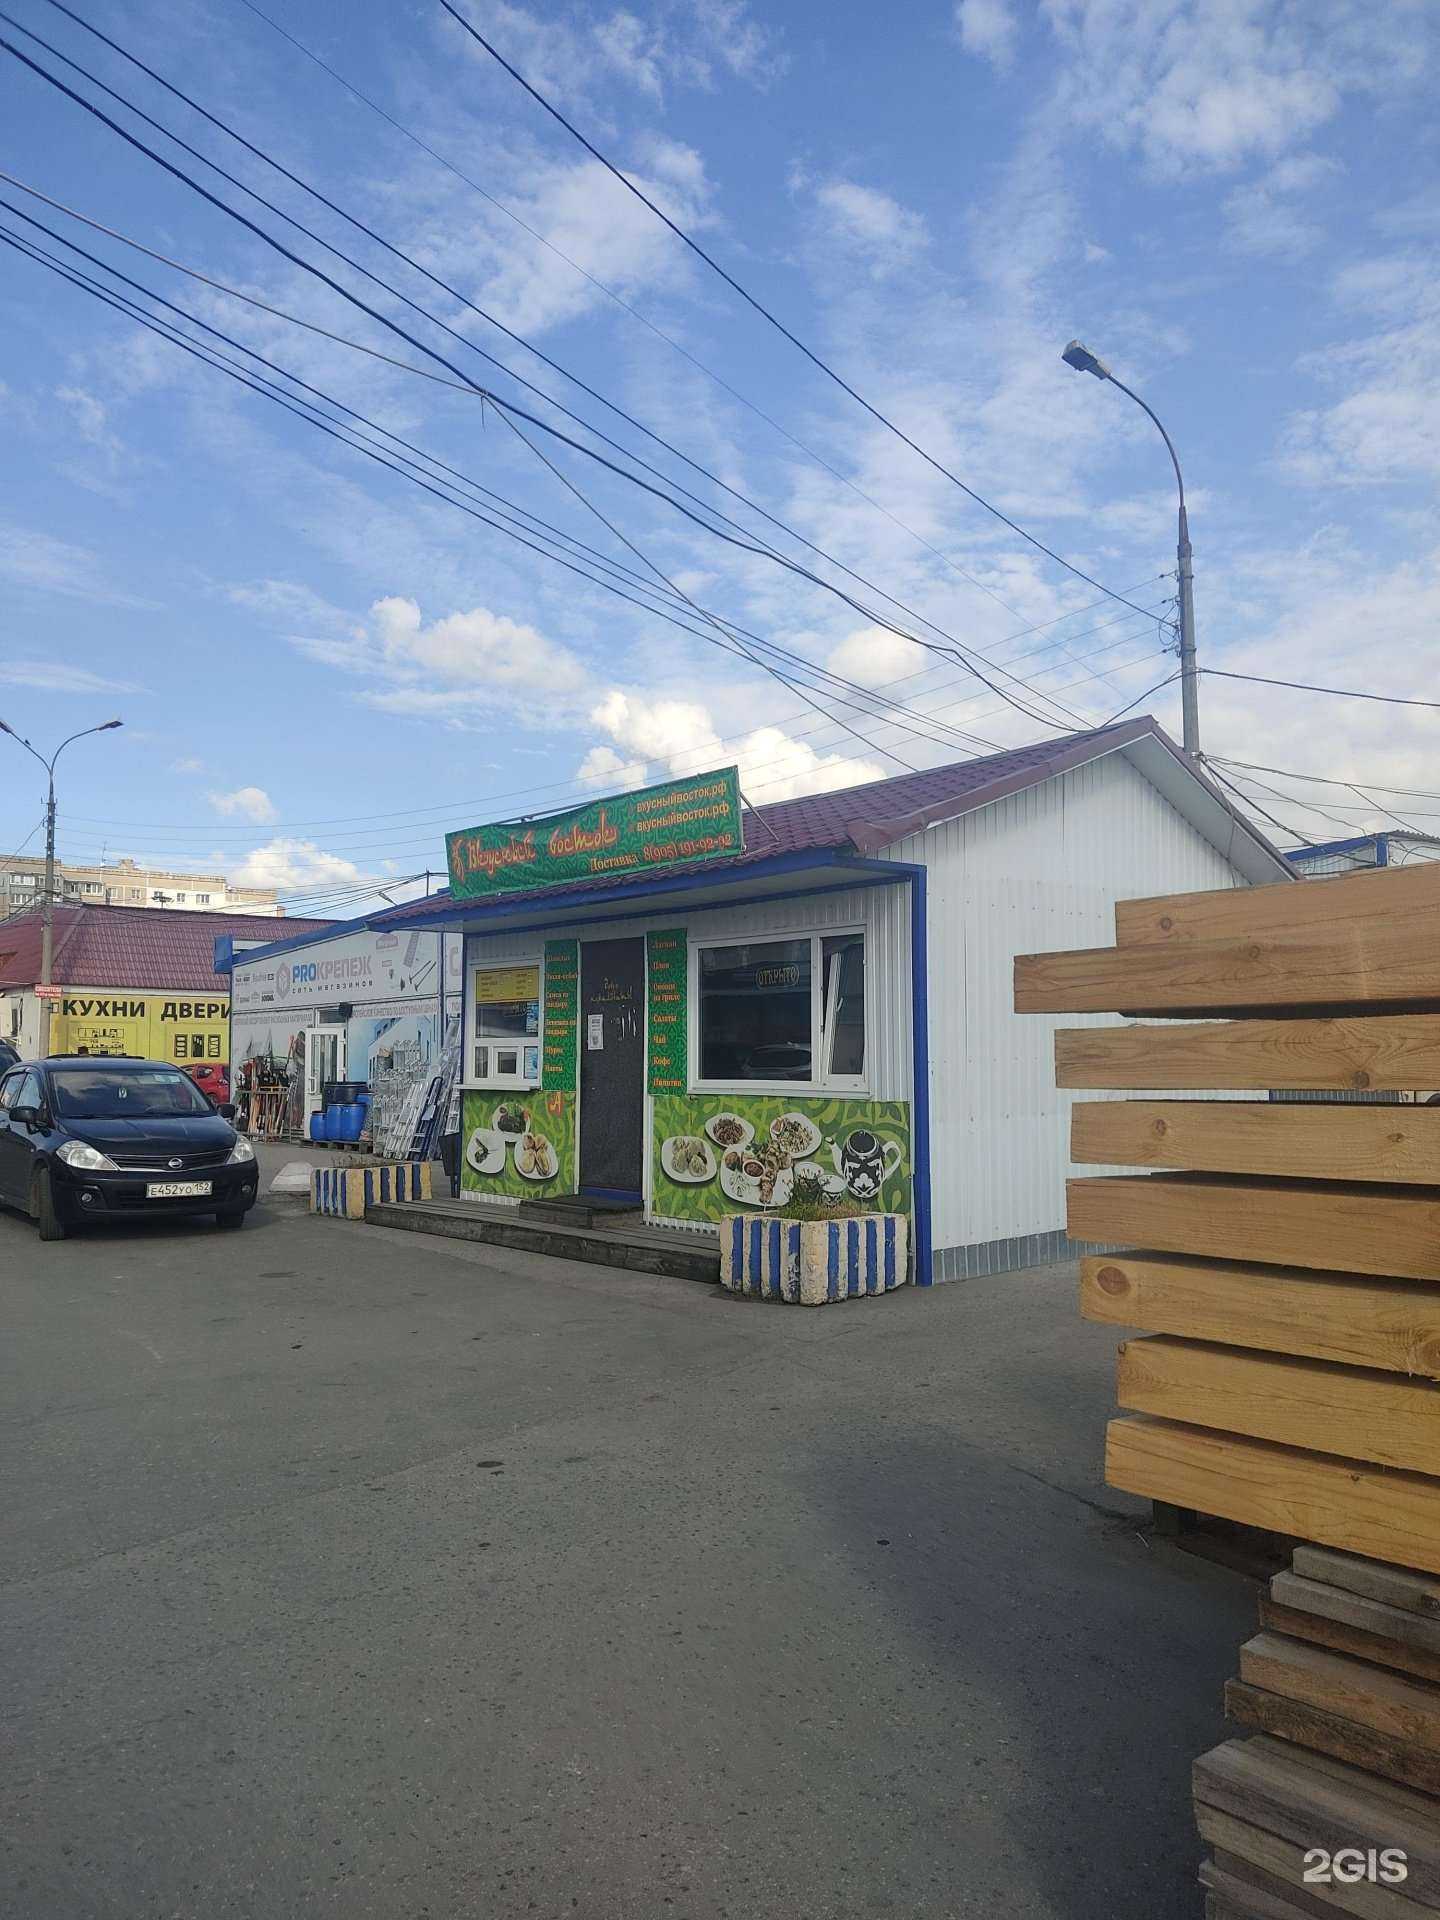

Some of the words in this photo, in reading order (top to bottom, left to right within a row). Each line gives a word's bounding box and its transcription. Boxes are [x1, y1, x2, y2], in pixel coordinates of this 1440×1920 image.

[637, 779, 727, 812] вкусныйвосток.рф
[637, 801, 730, 833] вкусныйвосток.рф
[549, 811, 618, 857] Восток
[590, 852, 639, 873] Доставка
[758, 966, 797, 985] ОТКРЫТО
[63, 1000, 145, 1017] КУХНИ
